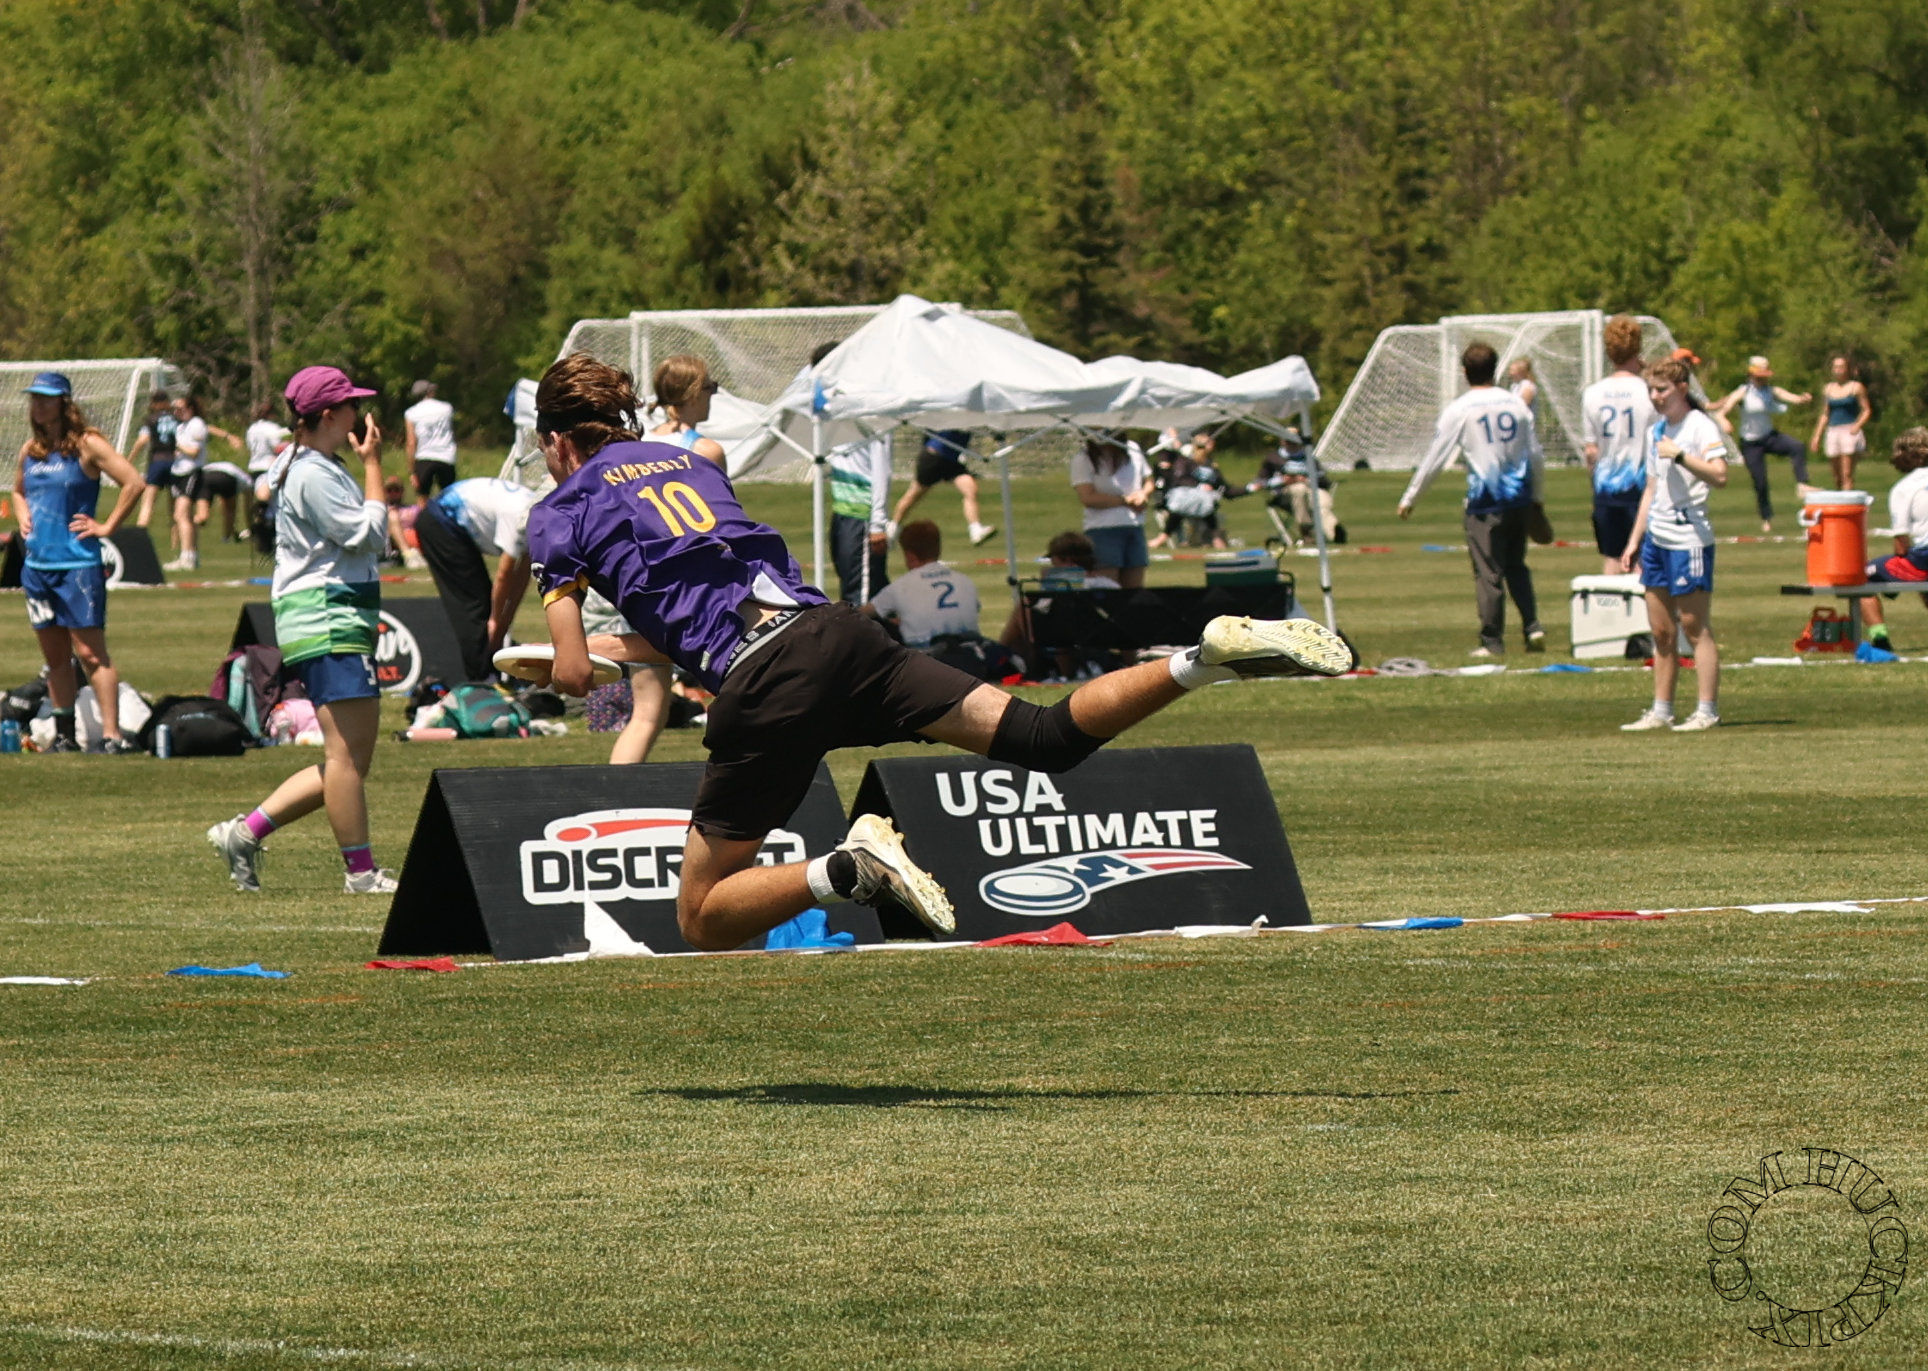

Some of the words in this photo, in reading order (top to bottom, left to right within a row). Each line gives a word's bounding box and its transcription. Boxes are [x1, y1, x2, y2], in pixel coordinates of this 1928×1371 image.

[1476, 410, 1519, 444] 19
[1599, 404, 1636, 439] 21
[602, 453, 692, 487] KIMBERLY
[636, 481, 718, 538] 10
[931, 580, 960, 609] 2
[935, 769, 1066, 817] USA
[978, 809, 1220, 857] ULTIMATE
[531, 842, 796, 893] DISCRT
